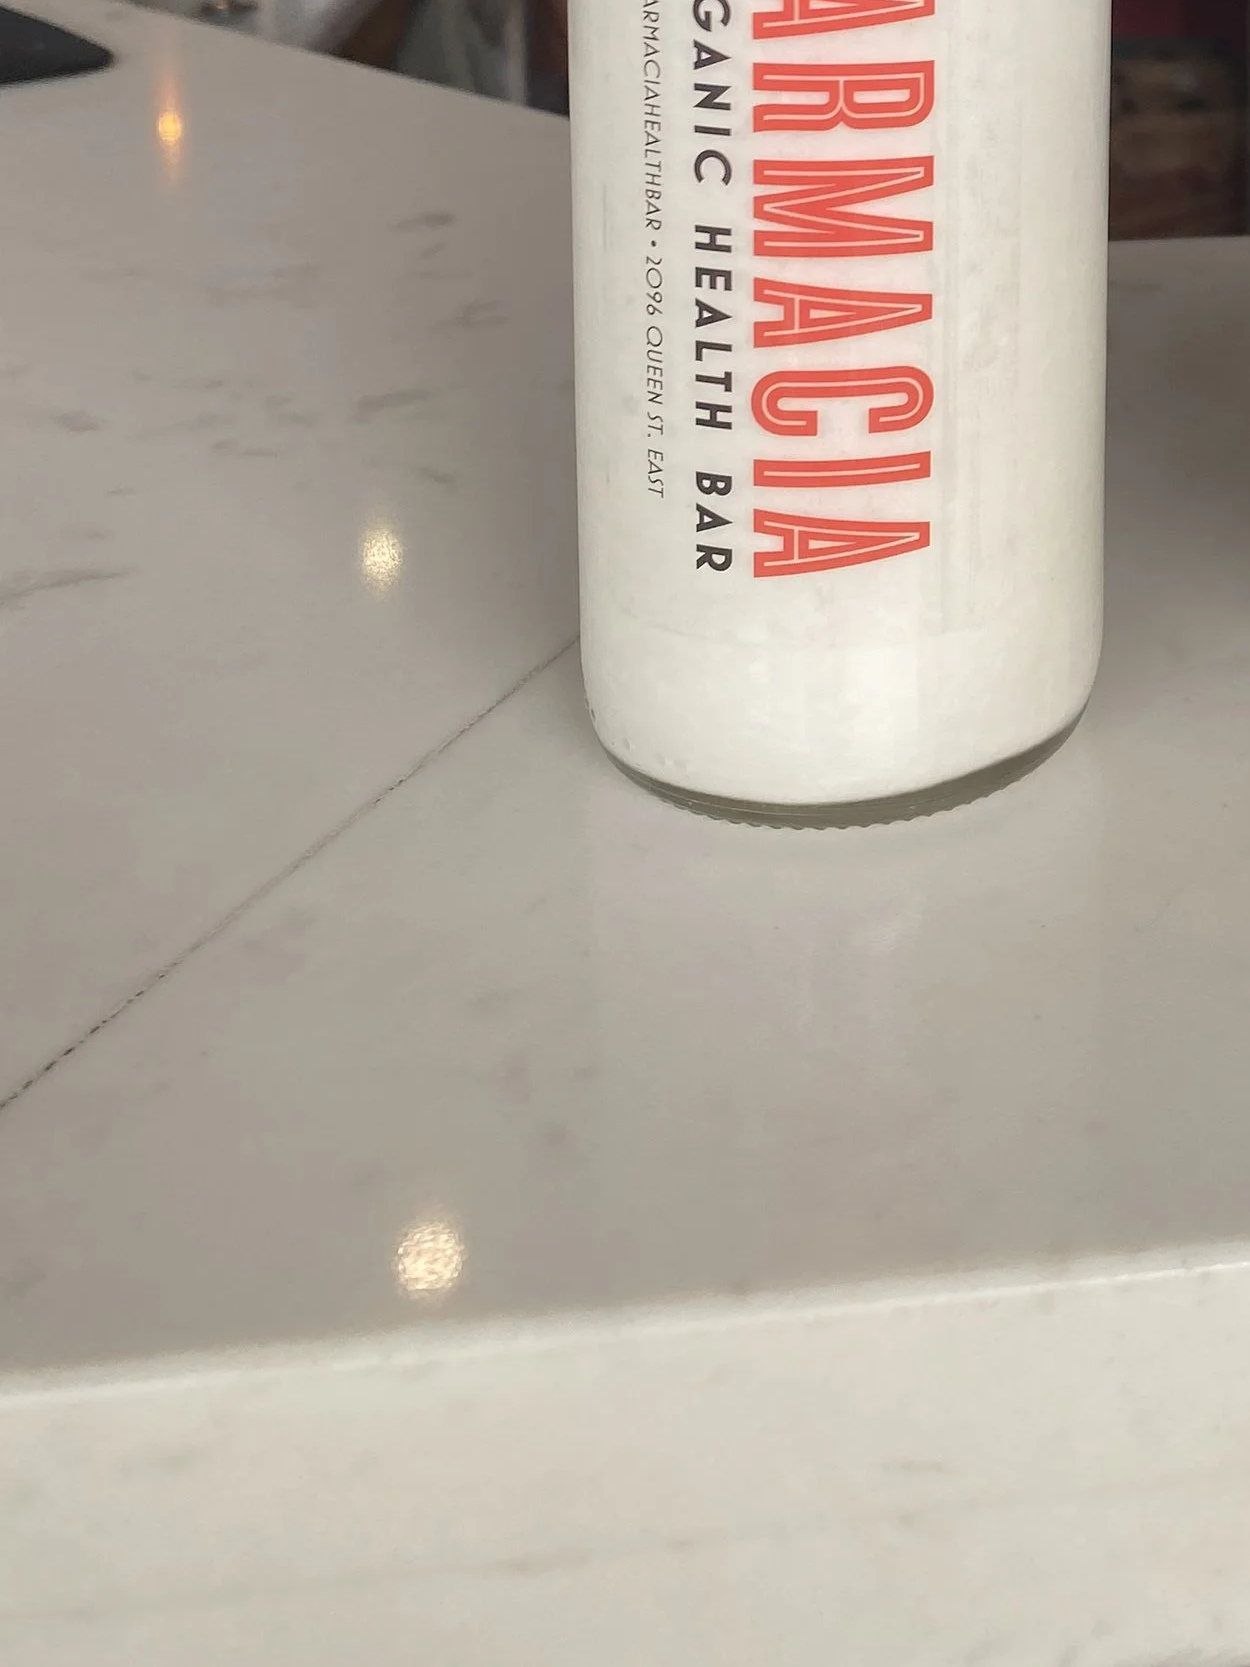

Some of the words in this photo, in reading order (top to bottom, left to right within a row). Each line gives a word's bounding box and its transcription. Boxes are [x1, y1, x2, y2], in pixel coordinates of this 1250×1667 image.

[645, 255, 663, 316] 2096
[695, 225, 732, 430] HEALTH
[646, 325, 663, 405] QUEEN
[646, 411, 664, 438] ST.
[647, 448, 665, 499] EAST
[696, 471, 733, 571] BAR
